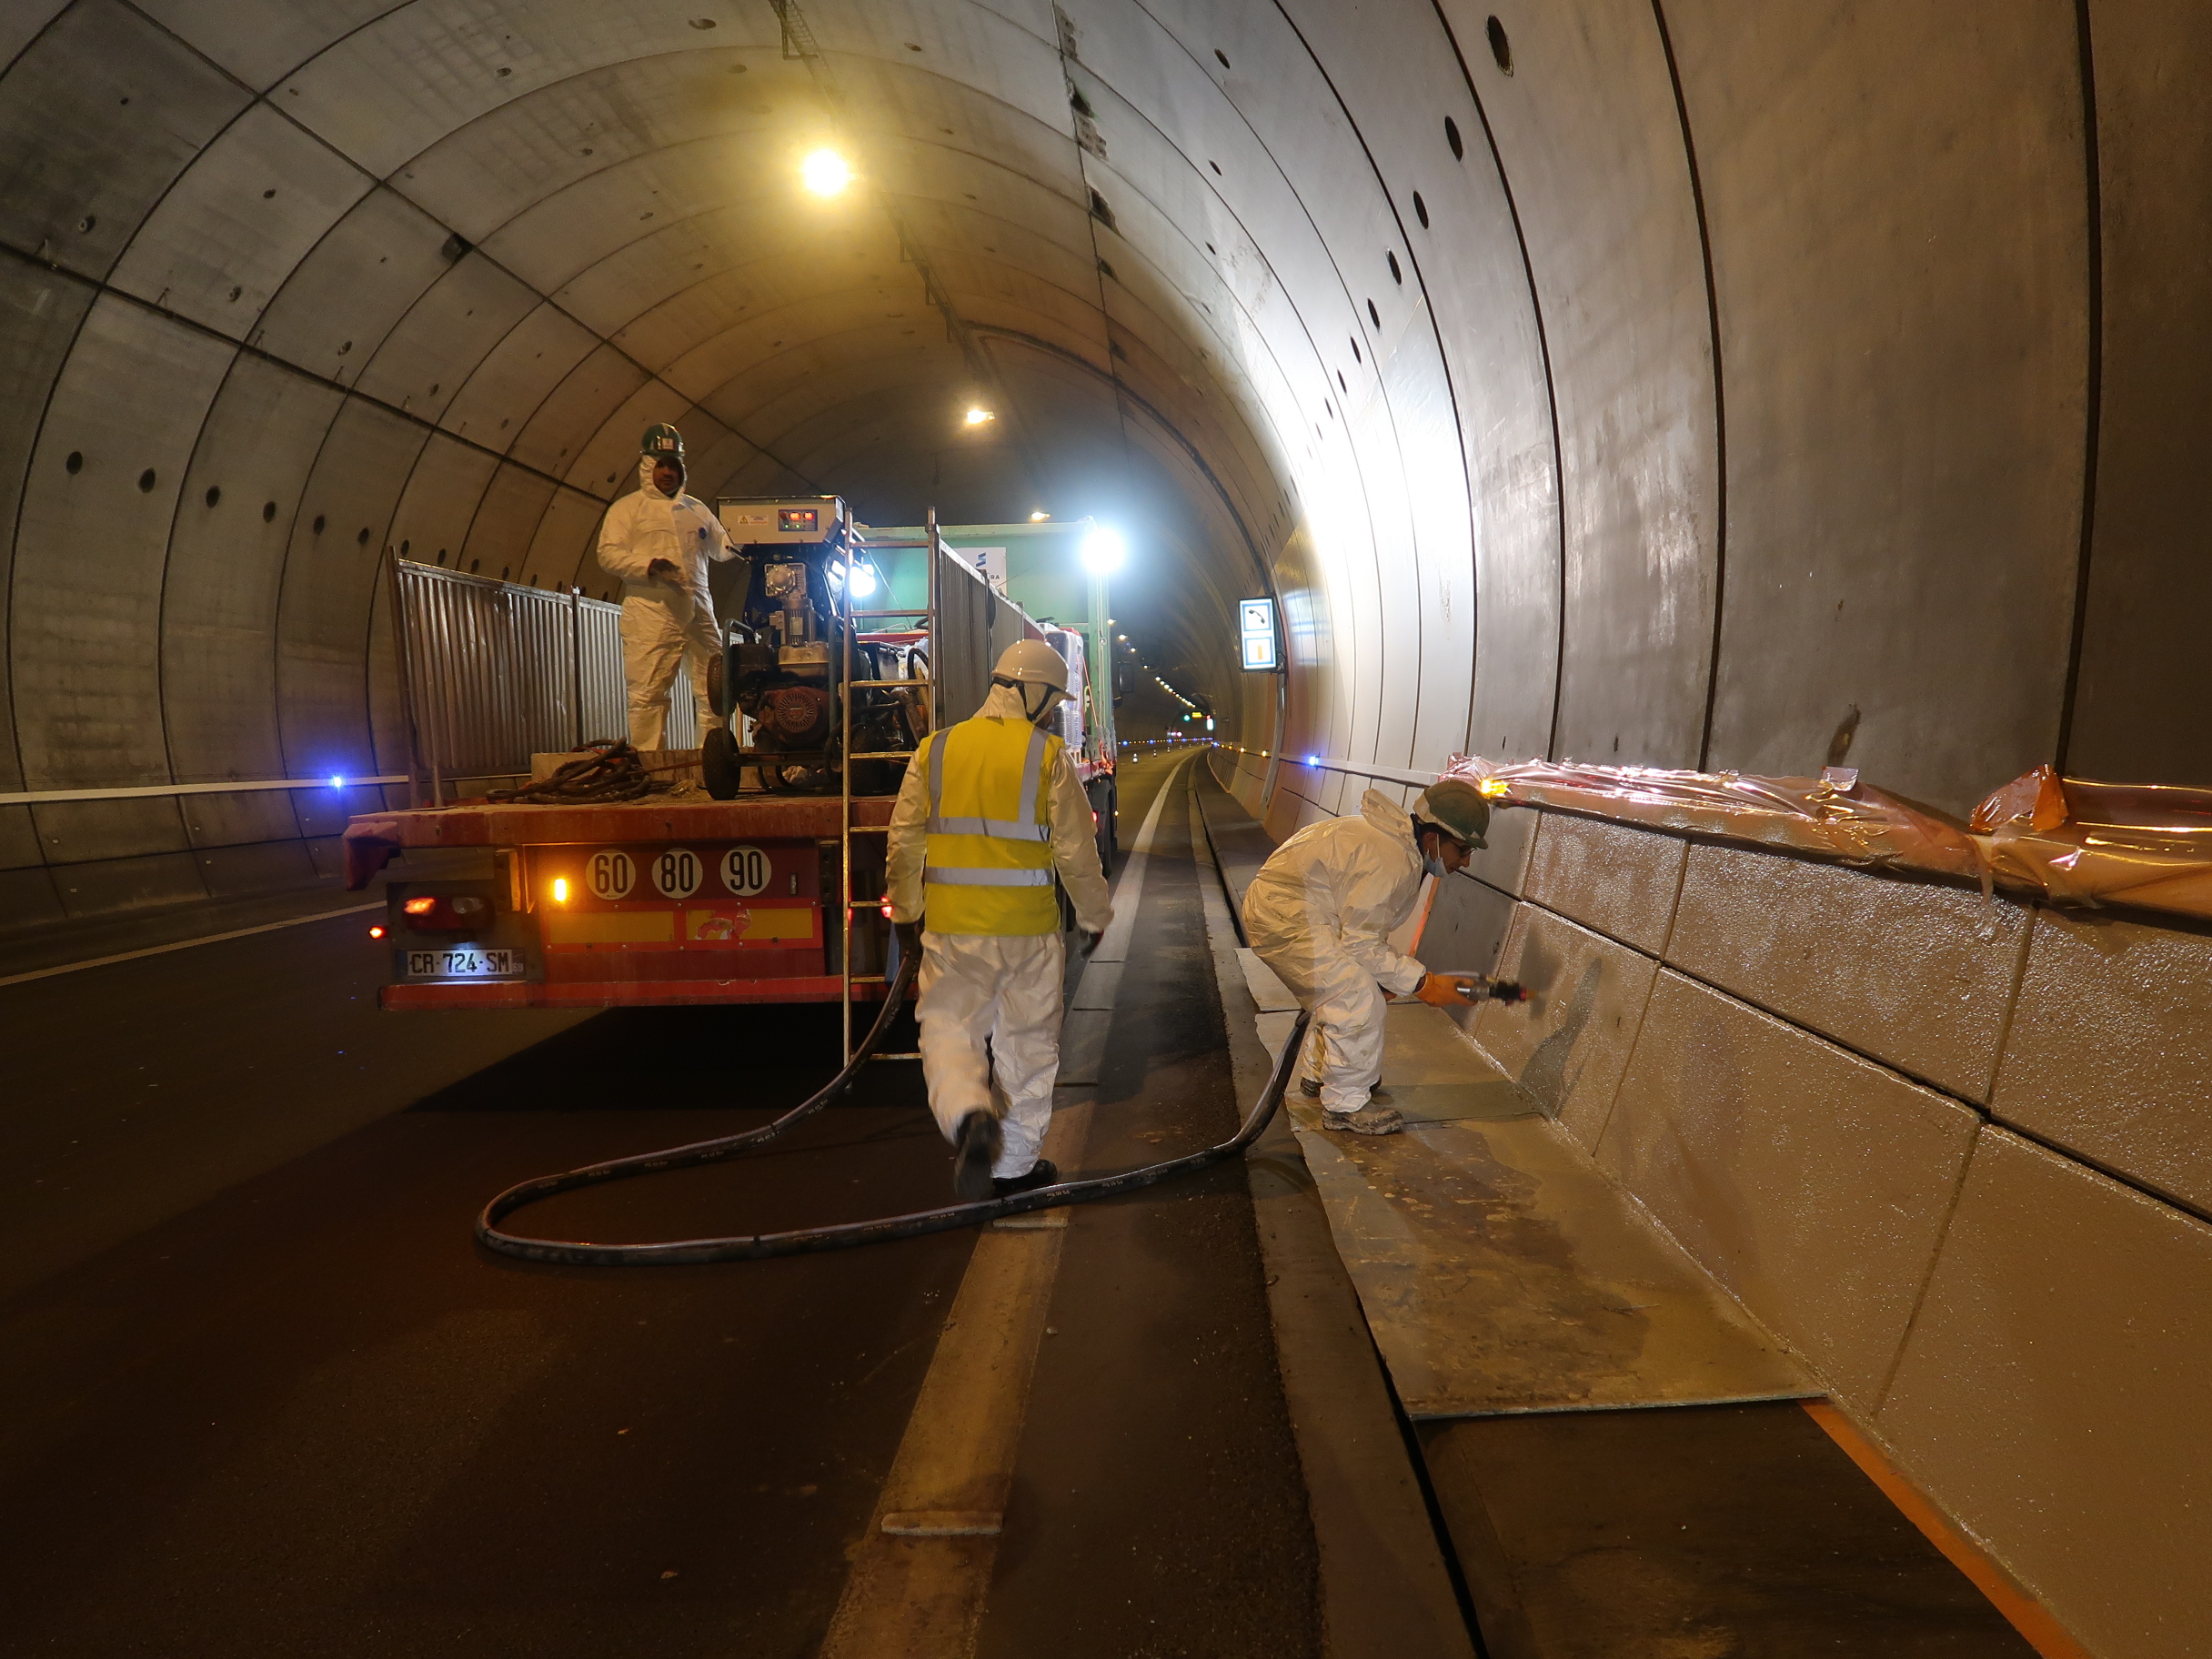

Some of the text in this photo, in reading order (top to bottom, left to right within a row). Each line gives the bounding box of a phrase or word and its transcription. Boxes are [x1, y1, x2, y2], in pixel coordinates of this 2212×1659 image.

[594, 854, 628, 894] 60
[661, 853, 694, 892] 80
[729, 850, 763, 890] 90
